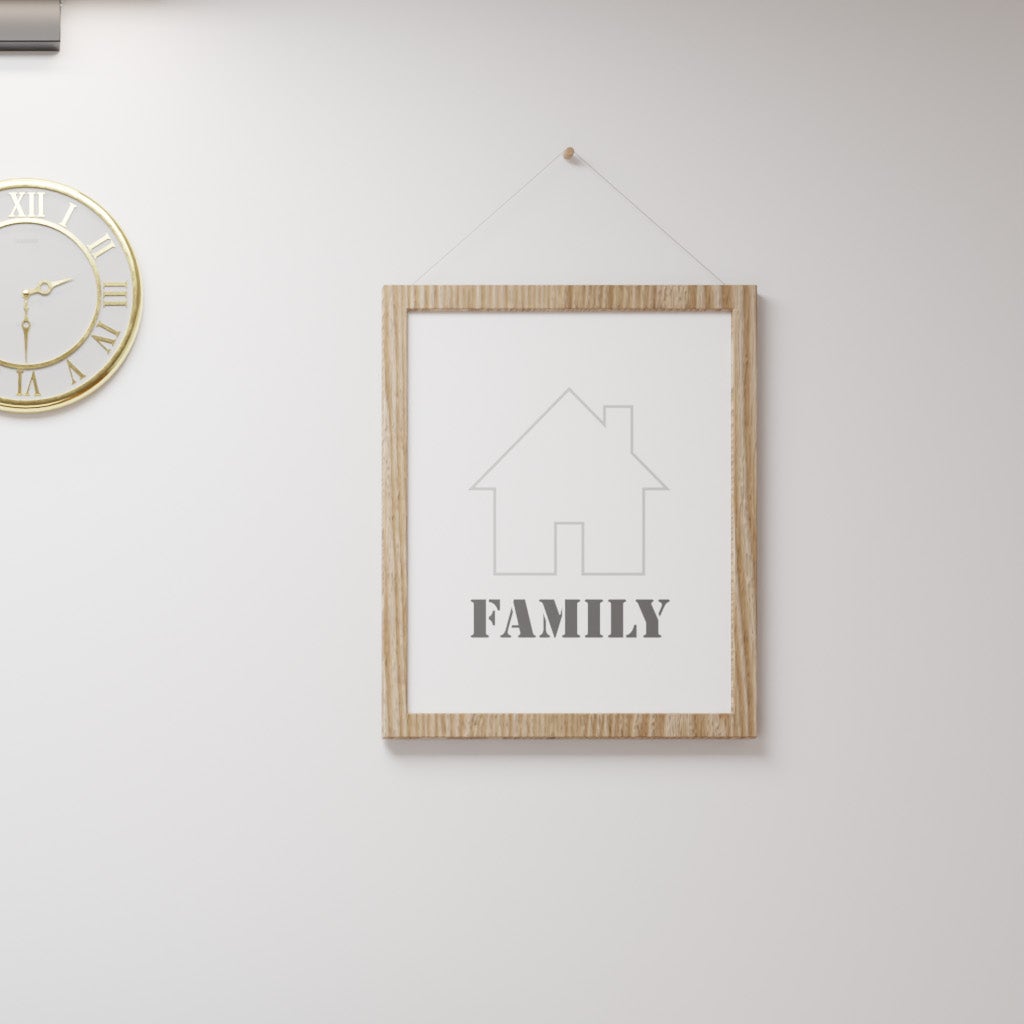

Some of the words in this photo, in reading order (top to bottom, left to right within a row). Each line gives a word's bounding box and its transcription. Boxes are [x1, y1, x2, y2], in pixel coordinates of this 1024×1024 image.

[8, 191, 45, 217] XII
[59, 202, 78, 227] I
[88, 234, 116, 259] II
[103, 282, 127, 308] III
[91, 321, 120, 353] IV
[16, 370, 41, 396] VI
[67, 359, 86, 385] V
[471, 599, 670, 638] FAMILY
